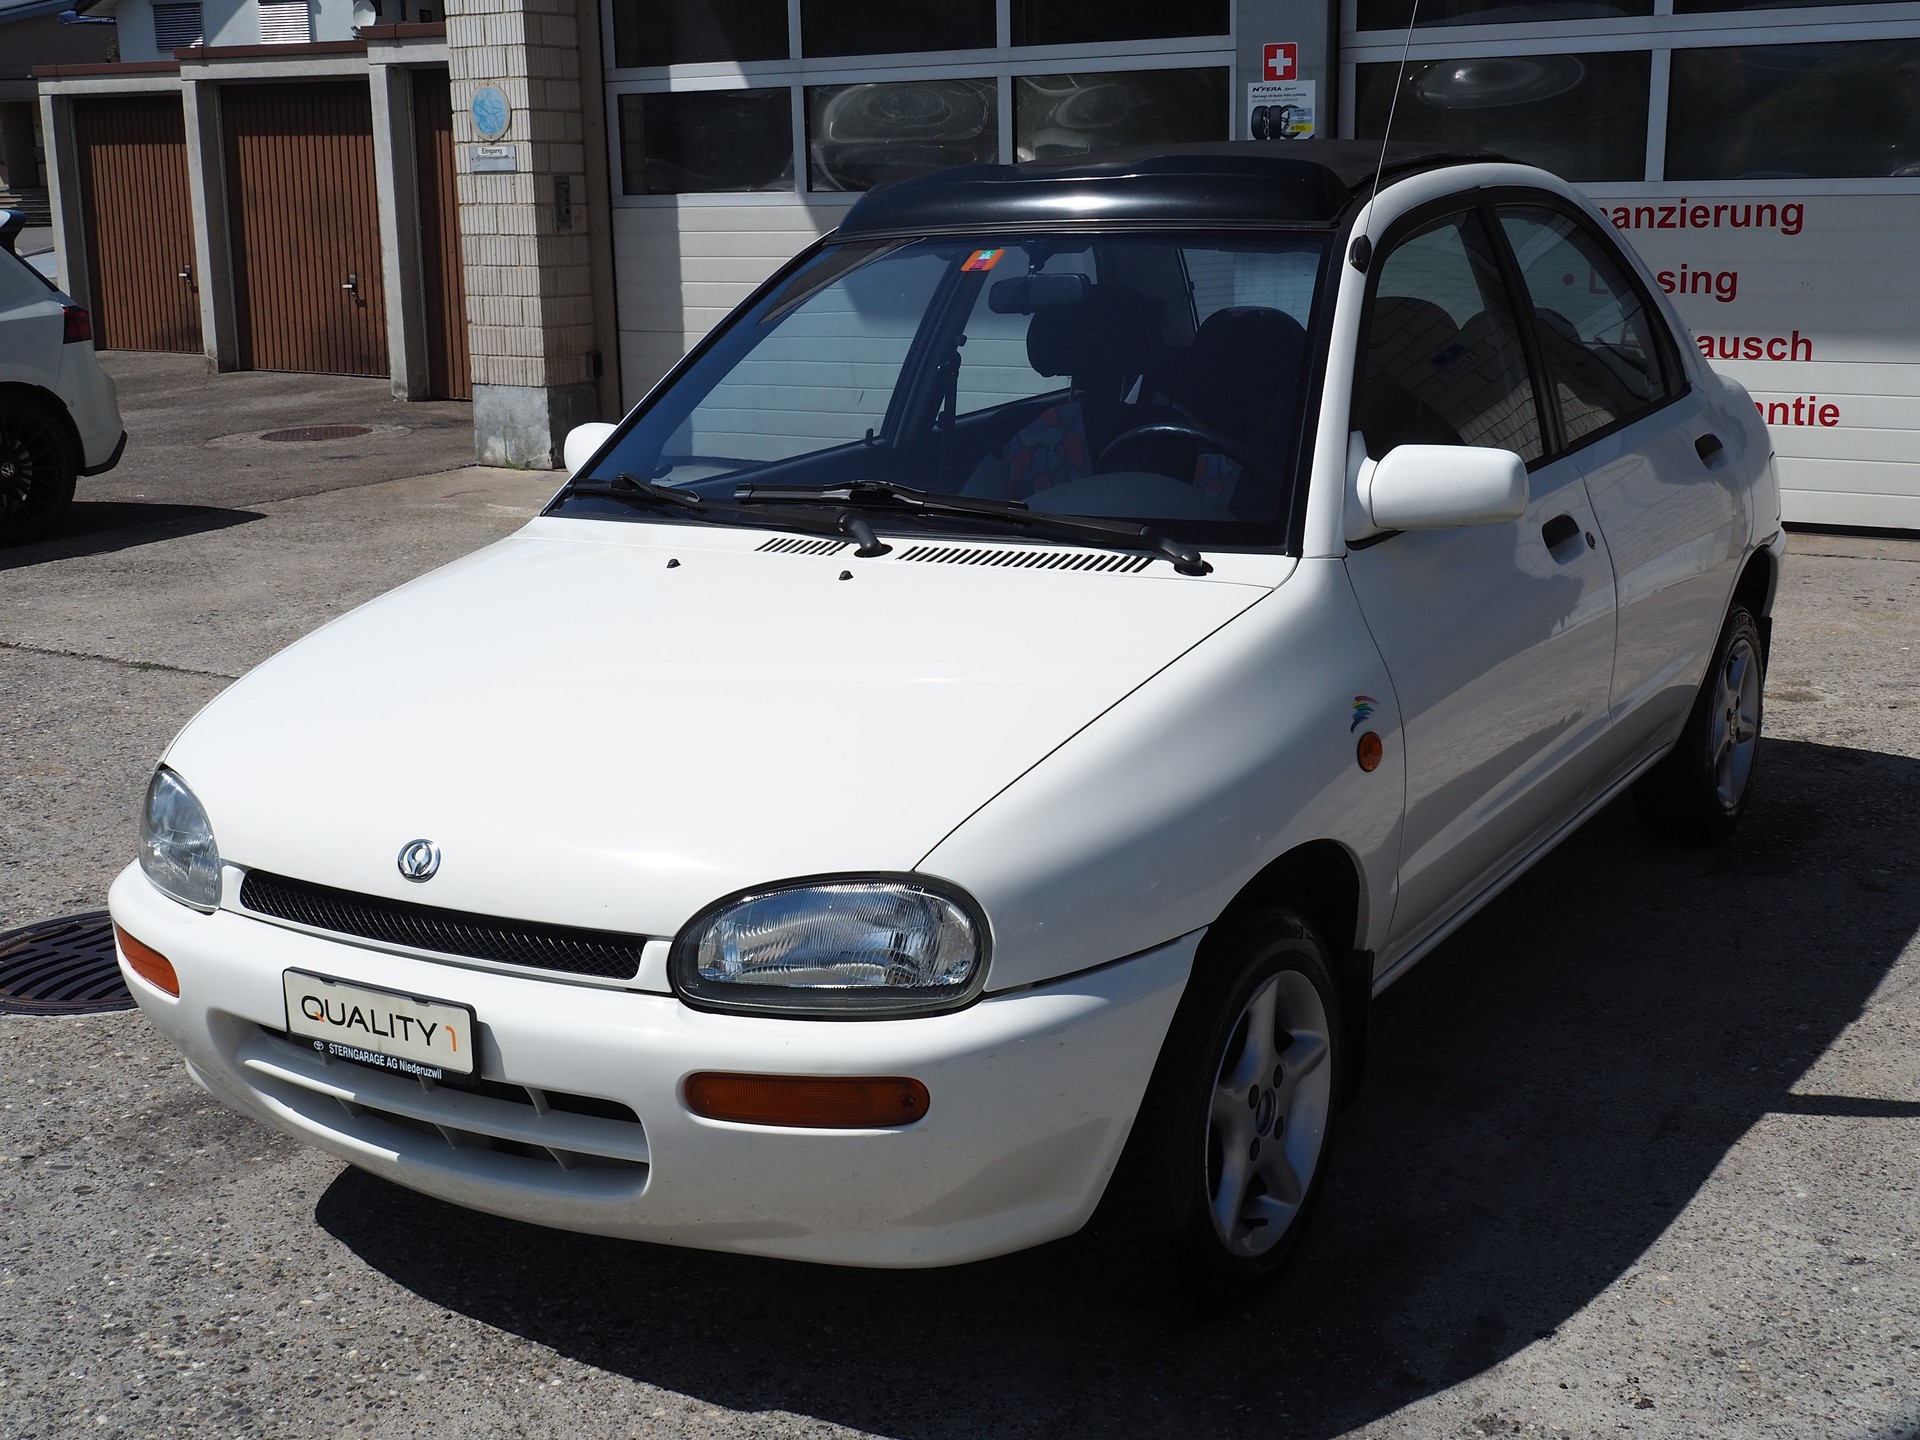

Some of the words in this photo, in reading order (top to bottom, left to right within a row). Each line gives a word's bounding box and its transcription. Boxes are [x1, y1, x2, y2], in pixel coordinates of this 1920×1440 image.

[482, 147, 502, 155] Eingang
[1599, 198, 1804, 235] anzierung
[1696, 331, 1812, 361] ausch
[1754, 396, 1839, 427] ntie
[301, 995, 438, 1046] QUALITY
[329, 1043, 385, 1066] STERNGARAGE
[386, 1056, 398, 1069] AG
[399, 1060, 442, 1080] Niederuzwil
